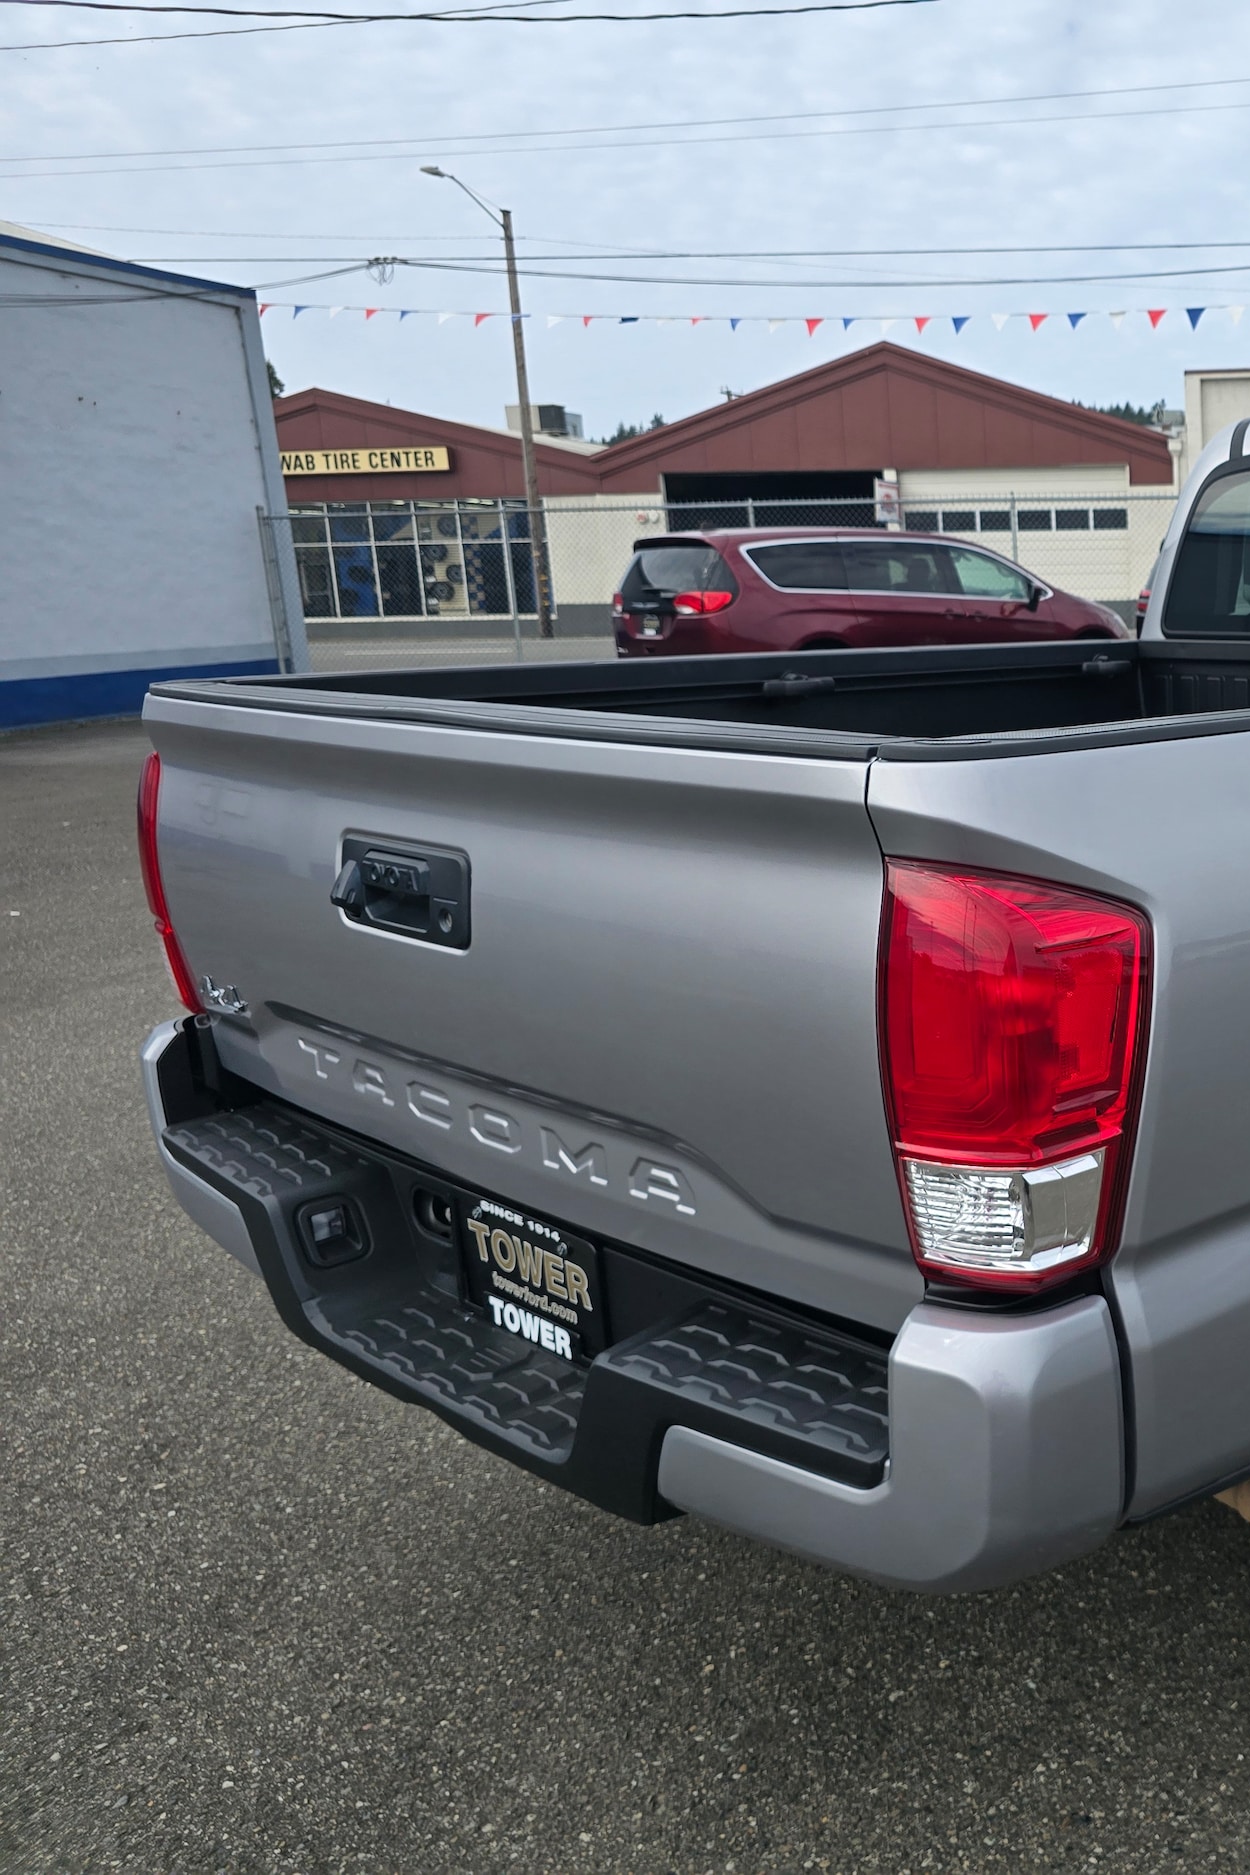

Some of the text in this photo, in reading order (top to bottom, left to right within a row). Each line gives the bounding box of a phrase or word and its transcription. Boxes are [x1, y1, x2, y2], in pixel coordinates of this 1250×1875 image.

[322, 452, 361, 470] TIRE
[368, 450, 436, 469] CENTER
[297, 1036, 698, 1217] TACOMA
[480, 1200, 525, 1227] SINCE
[467, 1217, 593, 1312] TOWER
[491, 1270, 579, 1325] towerford.com
[488, 1295, 573, 1361] TOWER
